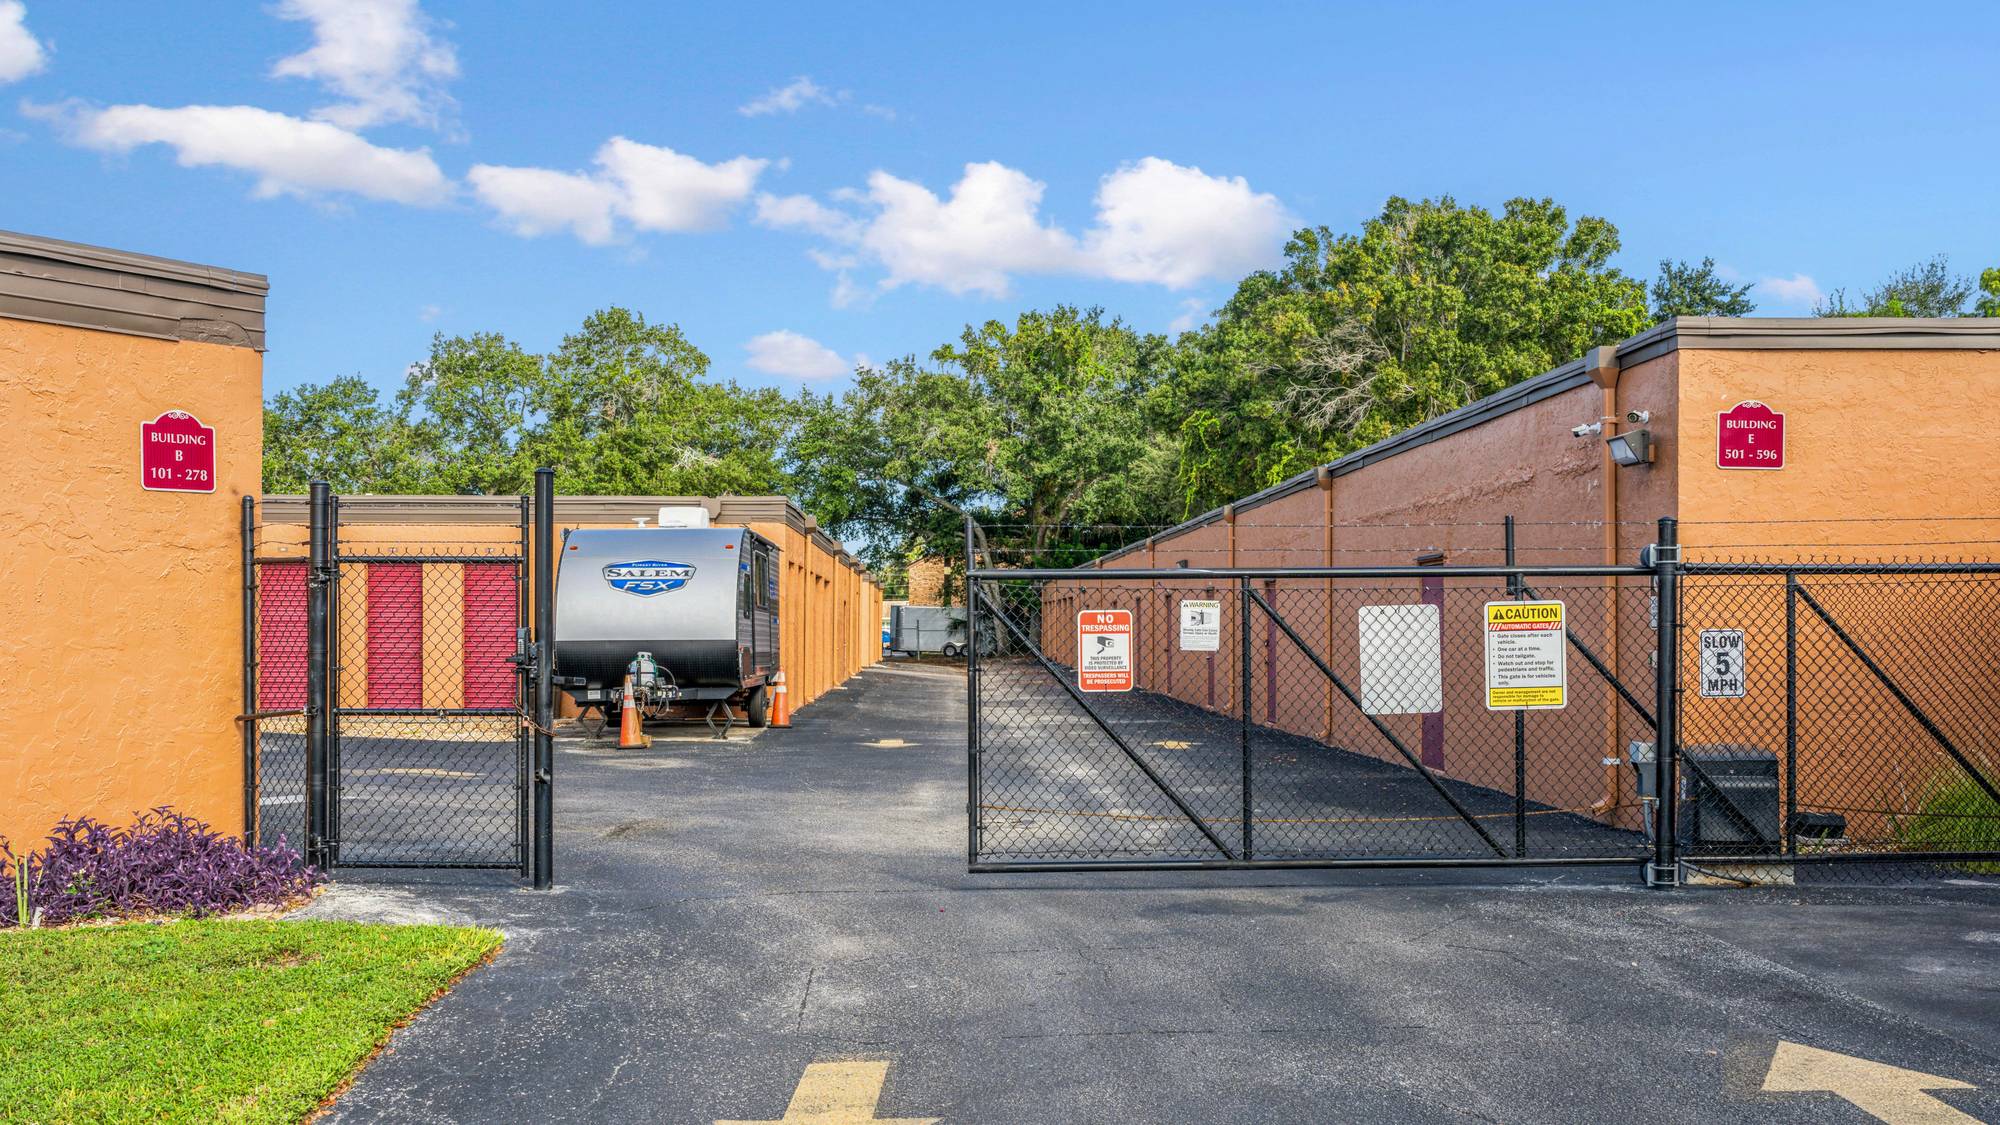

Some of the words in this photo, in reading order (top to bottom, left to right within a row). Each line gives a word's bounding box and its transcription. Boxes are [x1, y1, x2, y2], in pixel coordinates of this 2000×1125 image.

[1726, 420, 1776, 429] BUILDING
[151, 432, 206, 445] BUILDING
[1748, 434, 1754, 443] E
[175, 450, 183, 461] B
[1725, 449, 1744, 459] 501
[1756, 450, 1777, 460] 596
[151, 467, 171, 479] 101
[185, 469, 208, 481] 278
[607, 569, 689, 577] SALEM
[624, 581, 674, 590] FSX
[1097, 614, 1114, 623] NO
[1505, 608, 1558, 619] CAUTION
[1704, 636, 1740, 648] SLOW
[1716, 652, 1730, 675] 5
[1708, 679, 1738, 691] MPH
